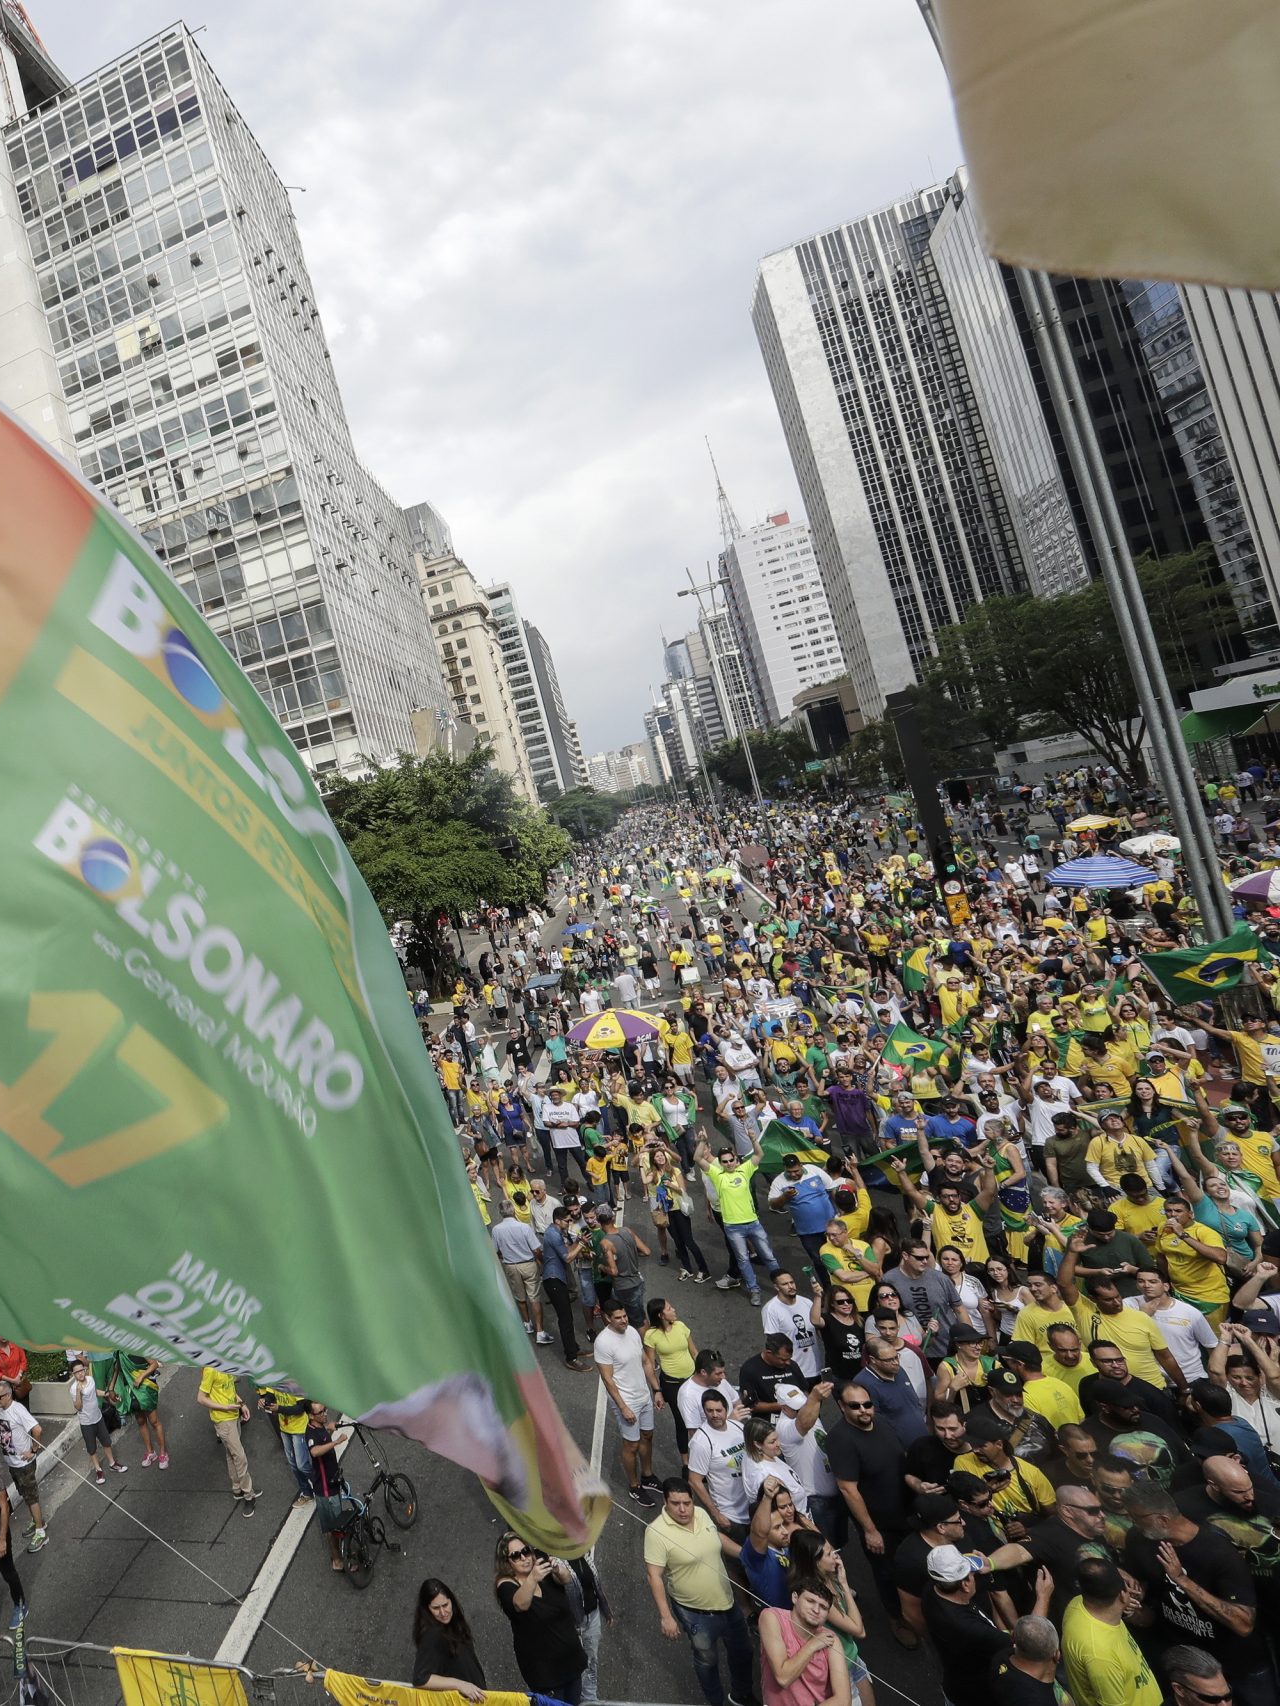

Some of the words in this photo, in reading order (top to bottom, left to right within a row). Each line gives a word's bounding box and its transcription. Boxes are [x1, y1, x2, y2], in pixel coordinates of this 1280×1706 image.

[131, 711, 253, 836] JUNTOS
[67, 782, 208, 903] PRESIDENTE
[33, 798, 365, 1111] BOLSONARO
[123, 947, 228, 1048] General
[53, 1297, 72, 1311] A
[167, 1249, 263, 1326] MAJOR
[15, 1641, 25, 1670] PAULO
